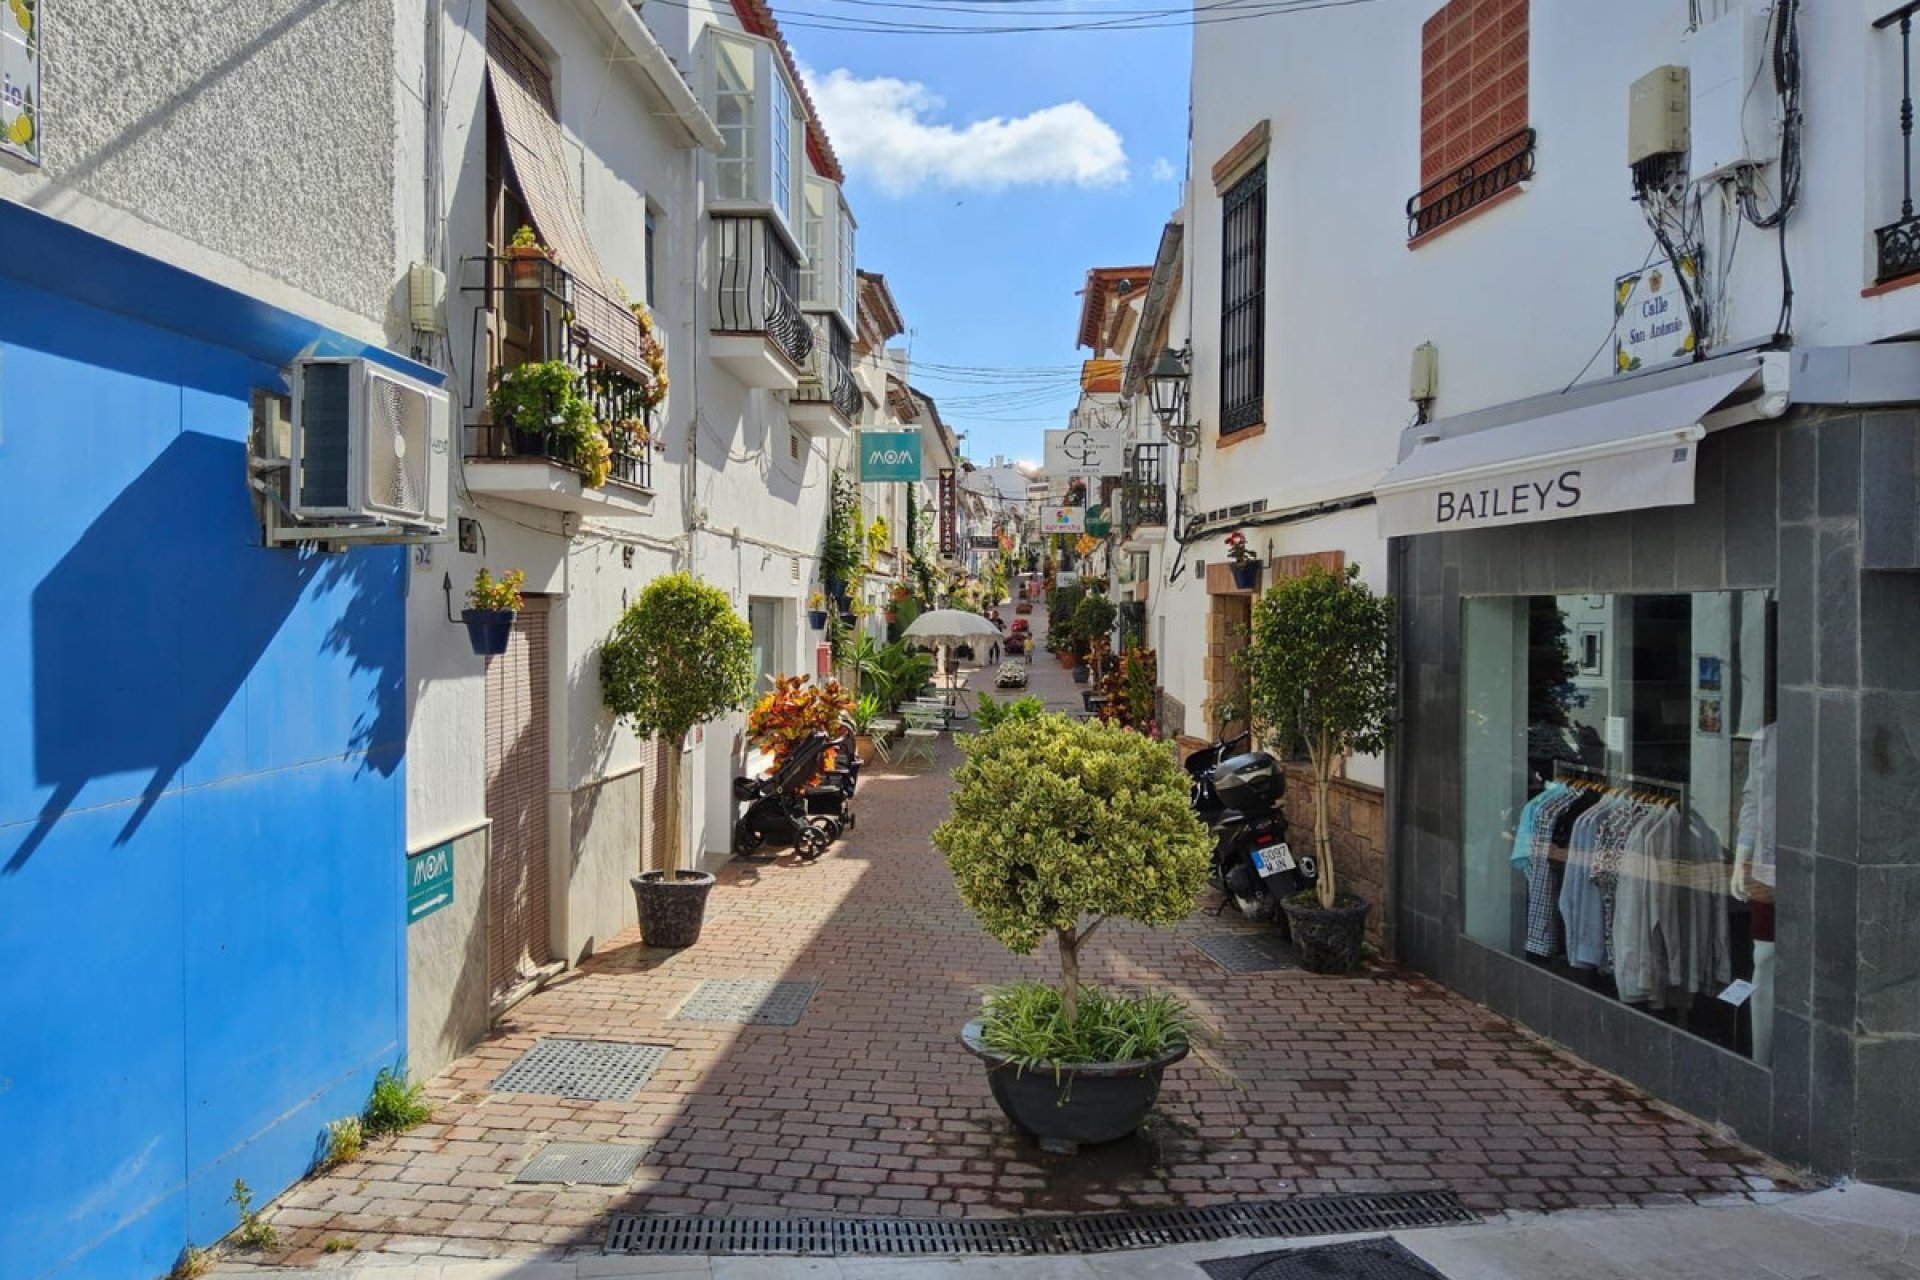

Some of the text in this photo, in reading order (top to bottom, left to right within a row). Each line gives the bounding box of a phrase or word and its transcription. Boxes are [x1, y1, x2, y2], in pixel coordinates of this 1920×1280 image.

[1643, 296, 1668, 317] Calle
[1630, 316, 1682, 344] San Antonio
[868, 449, 913, 465] MOM
[1437, 470, 1582, 523] BAILEYS
[413, 850, 449, 888] MOM
